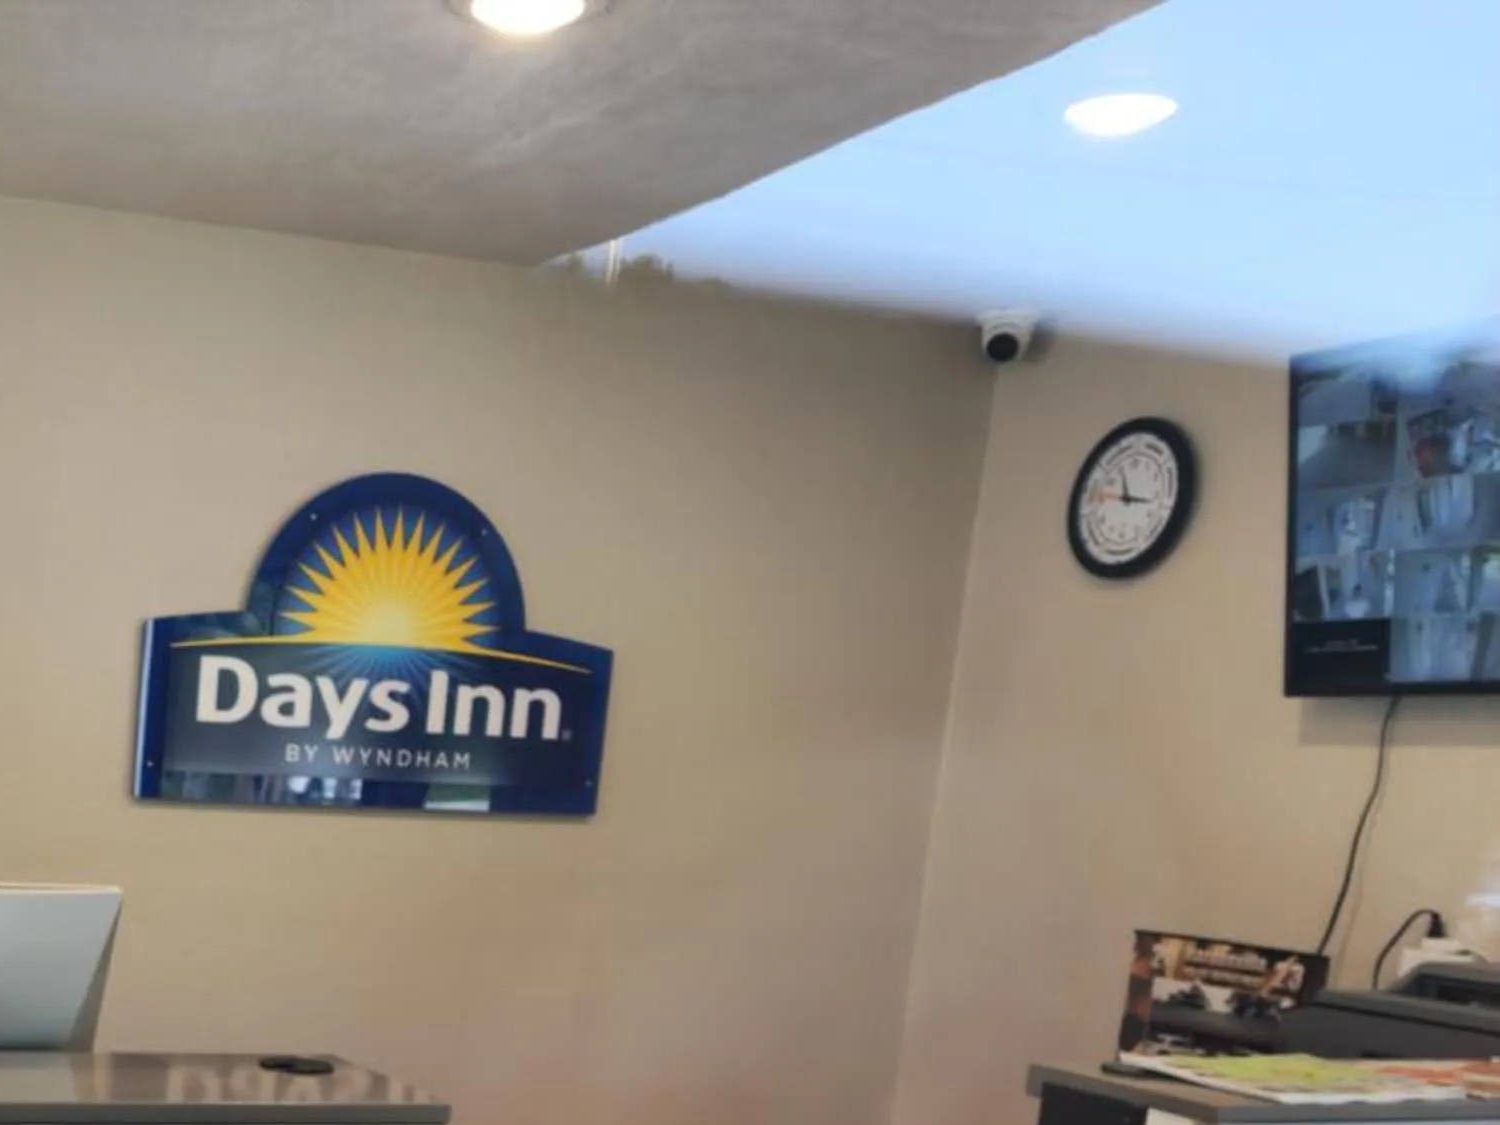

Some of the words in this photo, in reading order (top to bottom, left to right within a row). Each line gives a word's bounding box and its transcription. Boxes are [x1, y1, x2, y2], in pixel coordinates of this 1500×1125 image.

[195, 654, 411, 740] Days
[426, 670, 563, 741] Inn
[284, 743, 318, 764] BY
[332, 746, 471, 770] WYNDHAM
